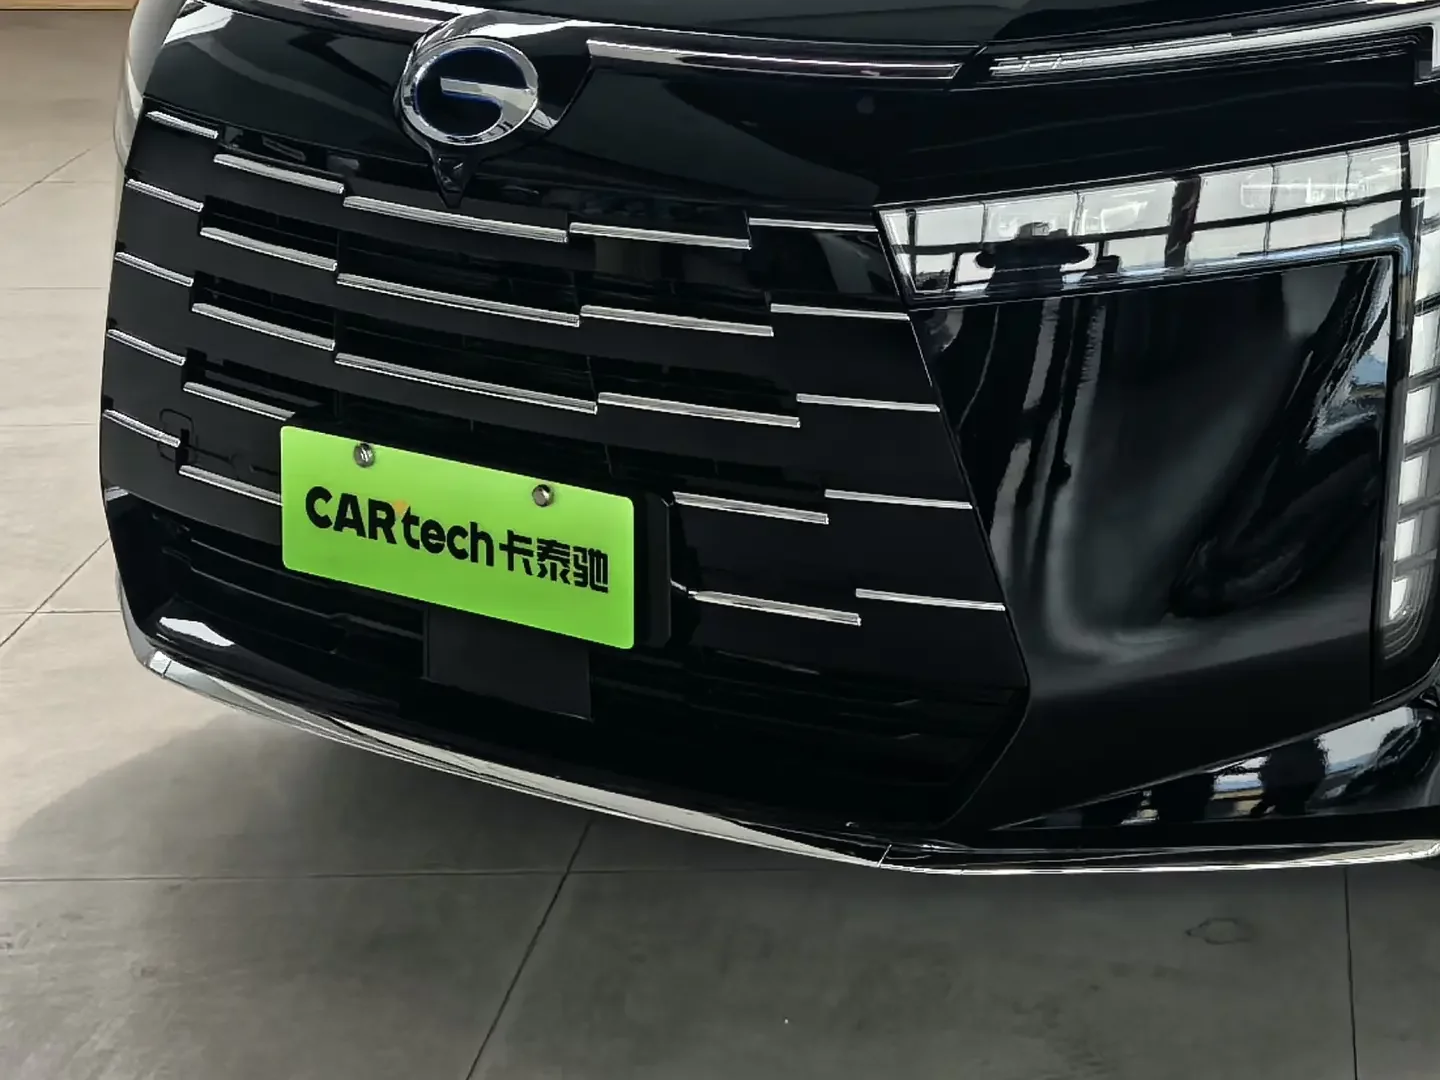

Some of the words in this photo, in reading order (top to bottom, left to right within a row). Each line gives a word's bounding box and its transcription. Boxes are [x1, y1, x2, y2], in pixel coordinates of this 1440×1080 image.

[305, 486, 494, 566] CARtech
[499, 529, 609, 593] 卡泰驰
